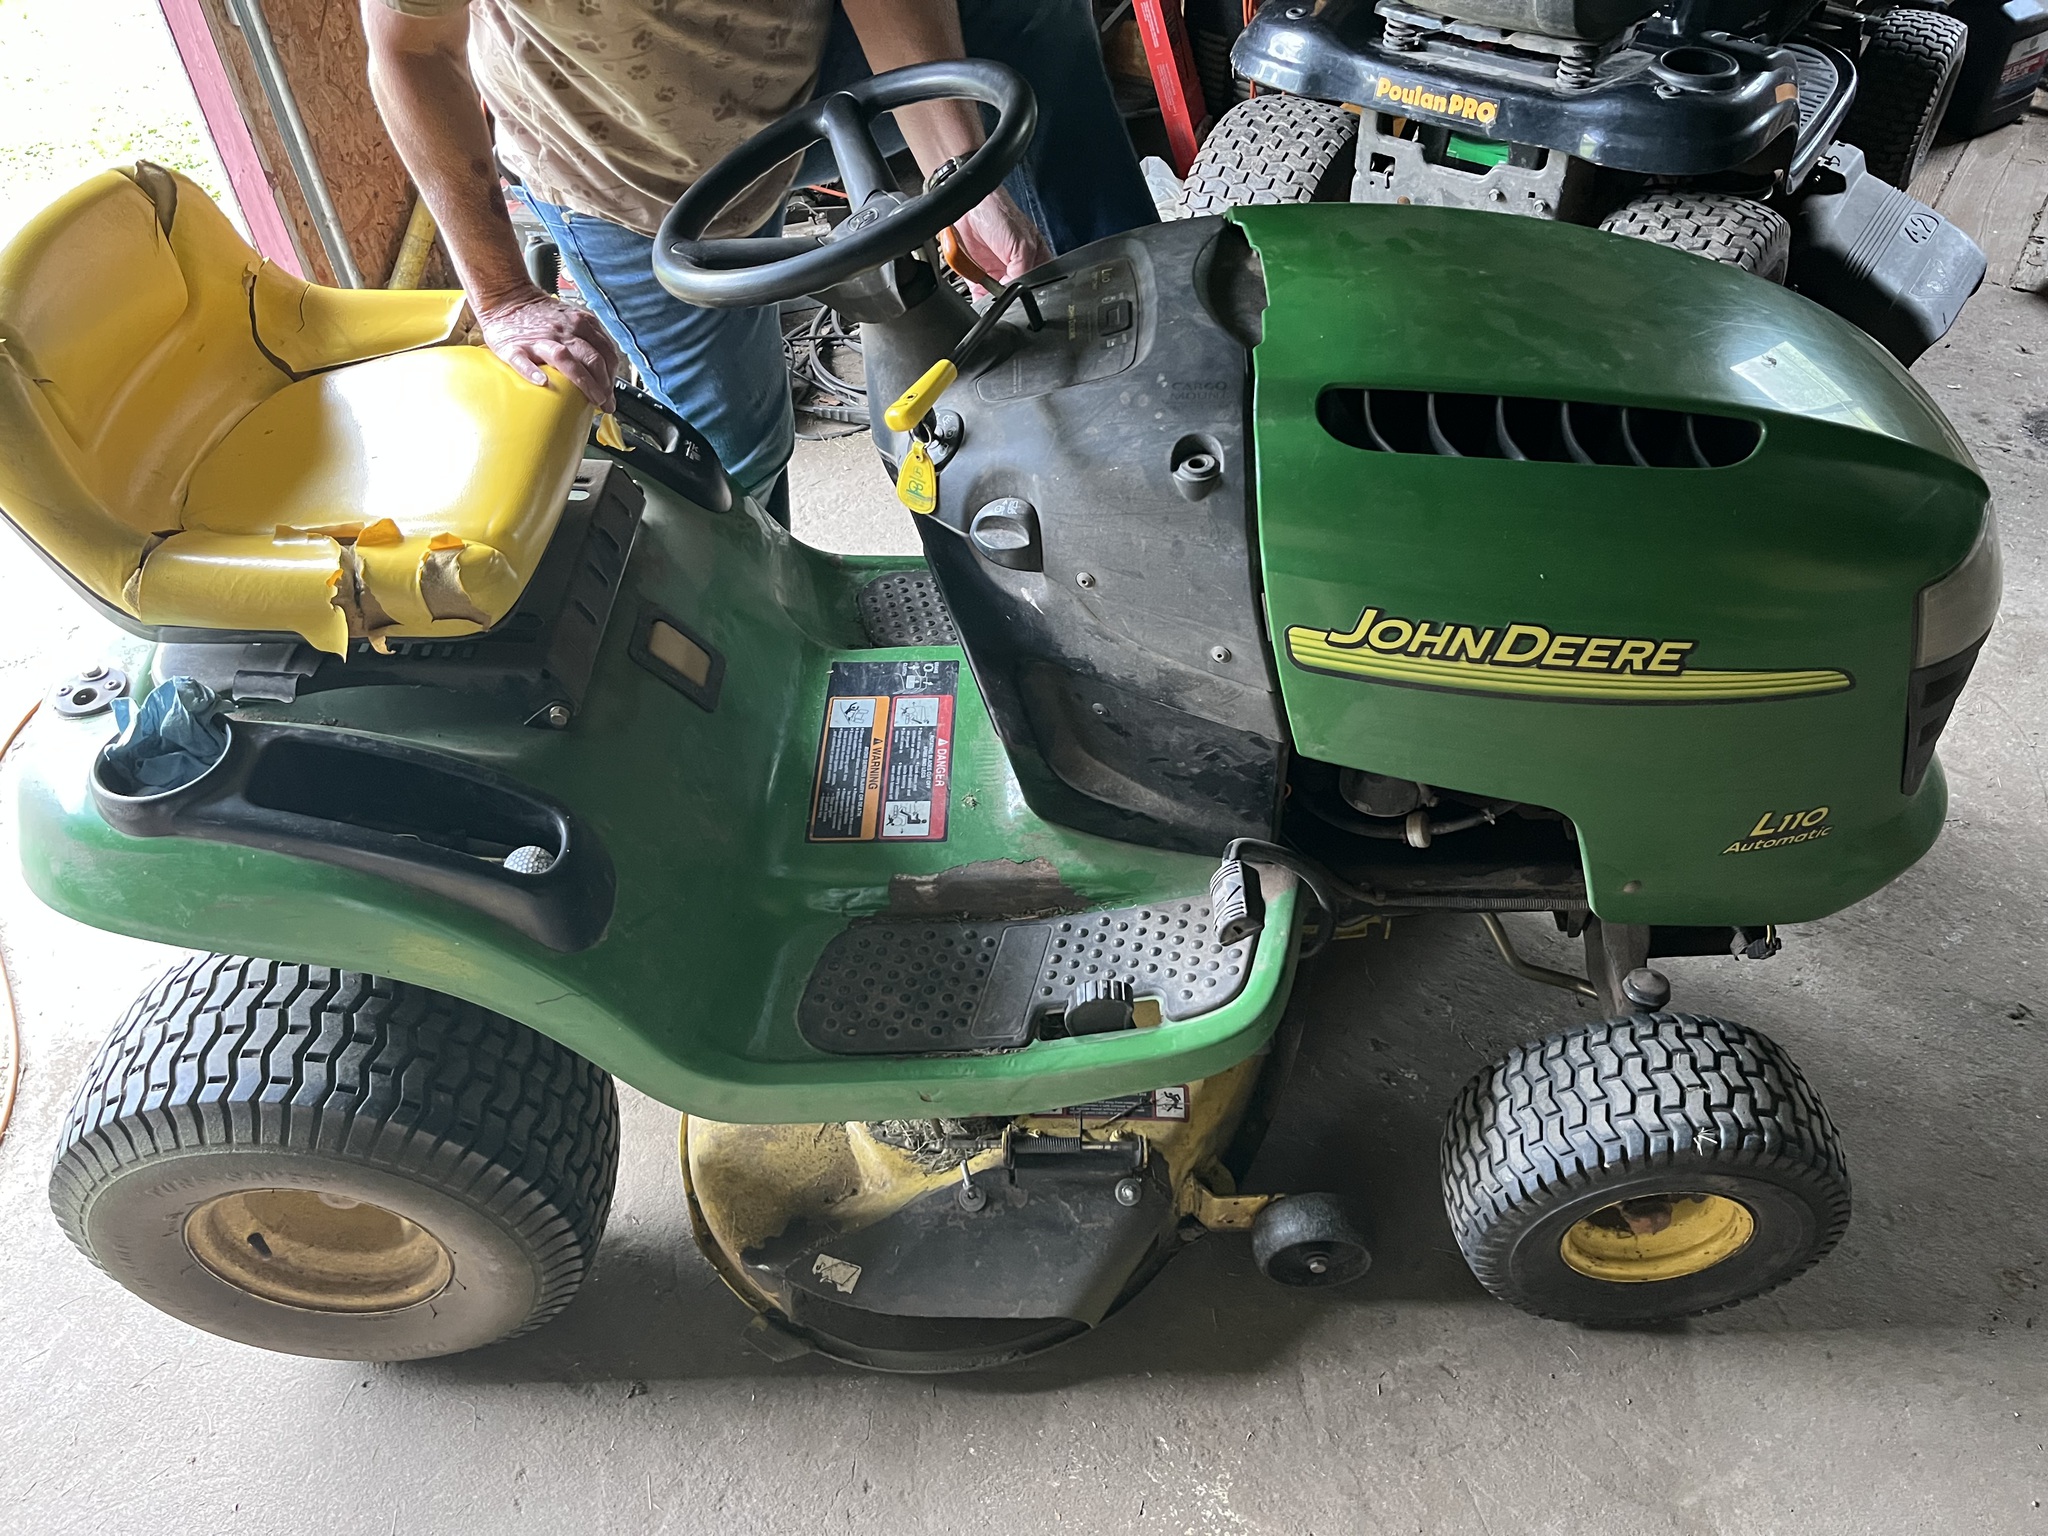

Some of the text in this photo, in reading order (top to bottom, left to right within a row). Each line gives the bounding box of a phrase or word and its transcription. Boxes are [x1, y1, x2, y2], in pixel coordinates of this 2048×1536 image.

[1376, 77, 1497, 123] Poulan PRO
[1171, 381, 1228, 391] CARGO
[1326, 607, 1695, 672] JOHN DEERE
[868, 748, 882, 790] WARNING
[934, 748, 948, 787] DANGER
[1722, 826, 1833, 854] Automatic
[1749, 806, 1829, 837] L110
